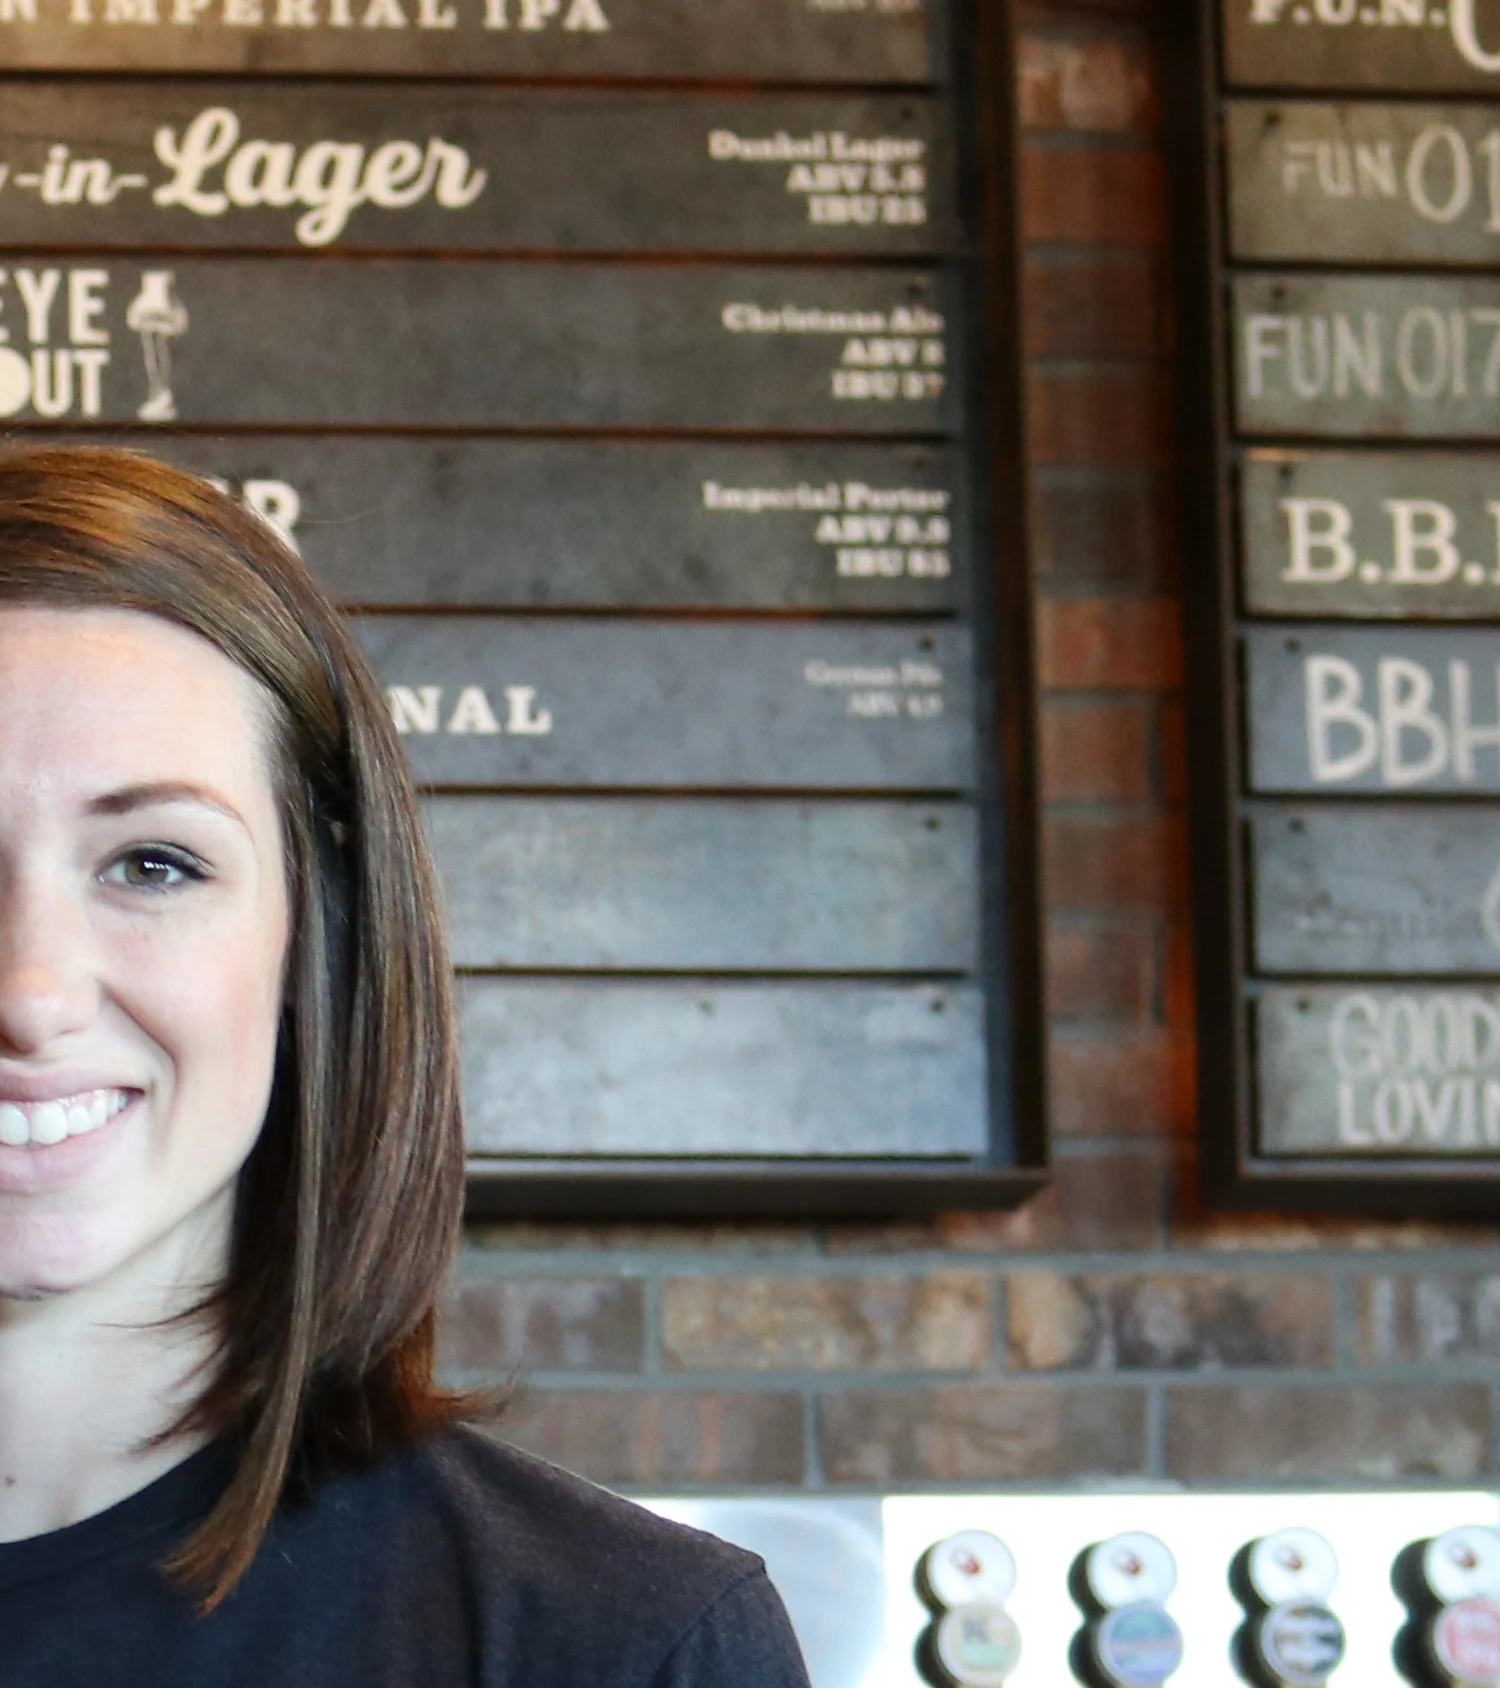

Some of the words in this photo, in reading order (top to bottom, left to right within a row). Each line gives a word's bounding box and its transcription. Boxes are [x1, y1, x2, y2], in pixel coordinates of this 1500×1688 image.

[1280, 139, 1396, 197] FUN
[722, 302, 887, 333] Christmas
[1243, 312, 1380, 399] FUN
